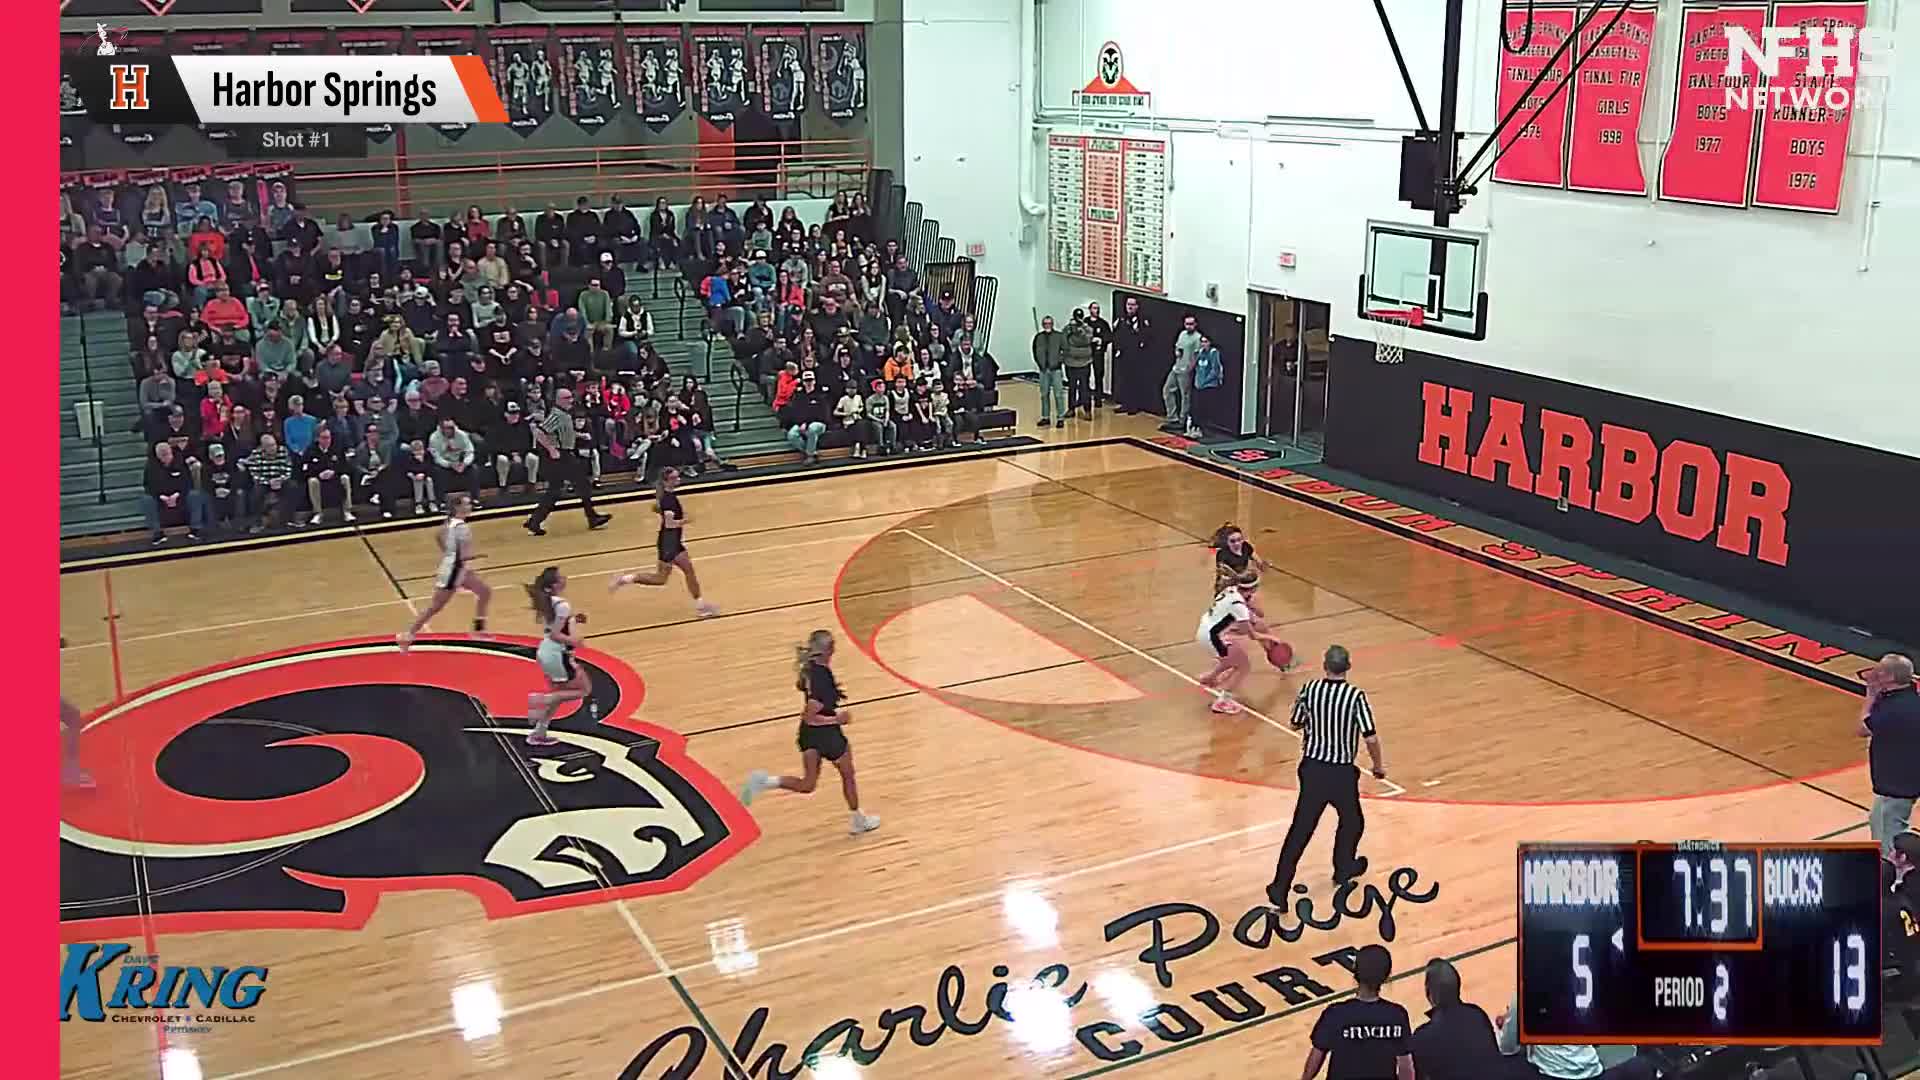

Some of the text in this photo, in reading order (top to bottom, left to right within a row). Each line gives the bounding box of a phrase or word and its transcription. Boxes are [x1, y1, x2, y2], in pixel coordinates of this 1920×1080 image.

[1583, 70, 1614, 85] FINAL
[1598, 99, 1630, 115] GIRLS
[1696, 105, 1727, 120] BOYS
[1598, 130, 1623, 144] 1998
[1695, 137, 1722, 152] 1977
[1790, 139, 1825, 156] BOYS
[1418, 381, 1792, 567] HARBOR
[1523, 858, 1824, 934] HARBOR 7:37 BUCKS
[1104, 867, 1440, 988] Paige
[1572, 934, 1867, 1011] 5 13
[1654, 964, 1730, 1021] PERIOD 2
